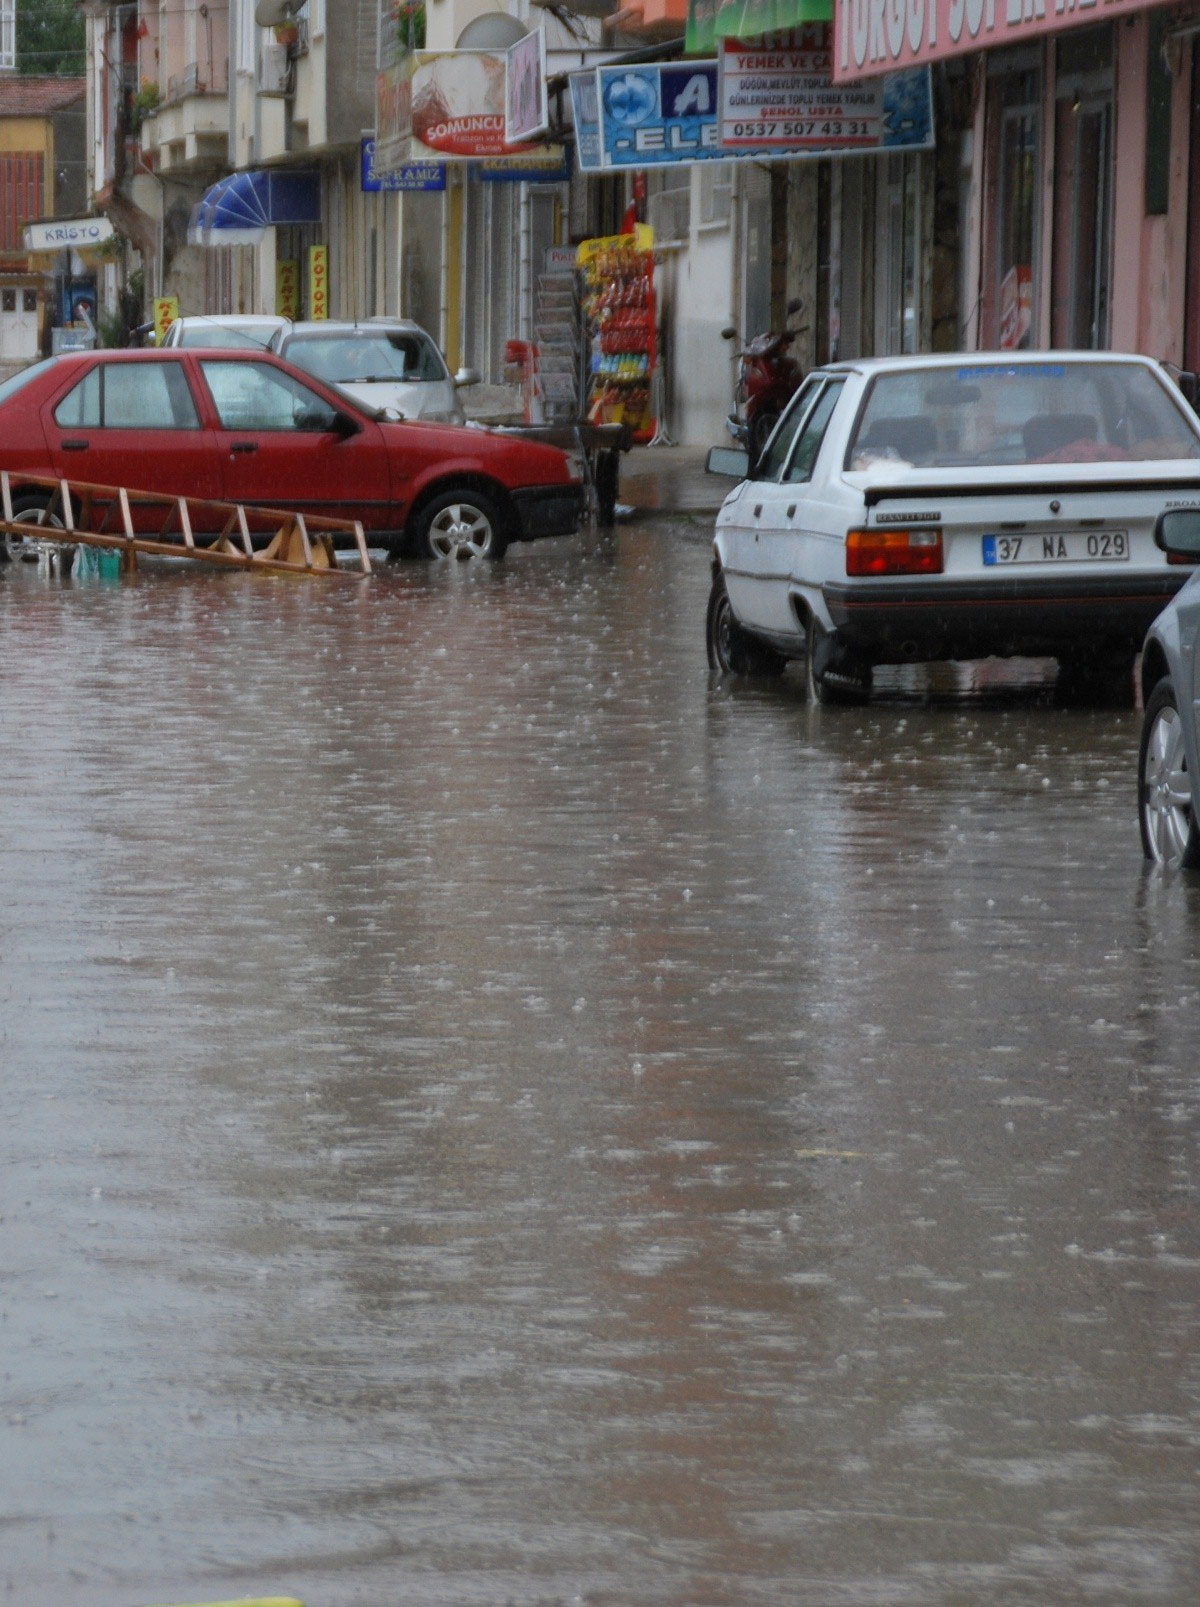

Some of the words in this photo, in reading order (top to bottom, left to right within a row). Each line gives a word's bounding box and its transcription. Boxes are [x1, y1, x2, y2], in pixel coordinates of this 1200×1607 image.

[737, 56, 784, 68] YEMEK
[790, 56, 808, 68] VE
[789, 94, 813, 104] TOPLU
[816, 93, 842, 104] YEMEK
[845, 93, 875, 104] YAPILIR
[760, 107, 803, 117] ŞENOL
[808, 107, 844, 116] USTA
[734, 123, 777, 136] 0537
[784, 122, 815, 135] 507
[821, 122, 842, 135] 43
[849, 121, 869, 134] 31
[475, 144, 502, 152] Ekmek
[45, 225, 100, 241] KRİSTO
[998, 538, 1023, 560] 37
[1043, 536, 1068, 558] NA
[1087, 534, 1125, 556] 029
